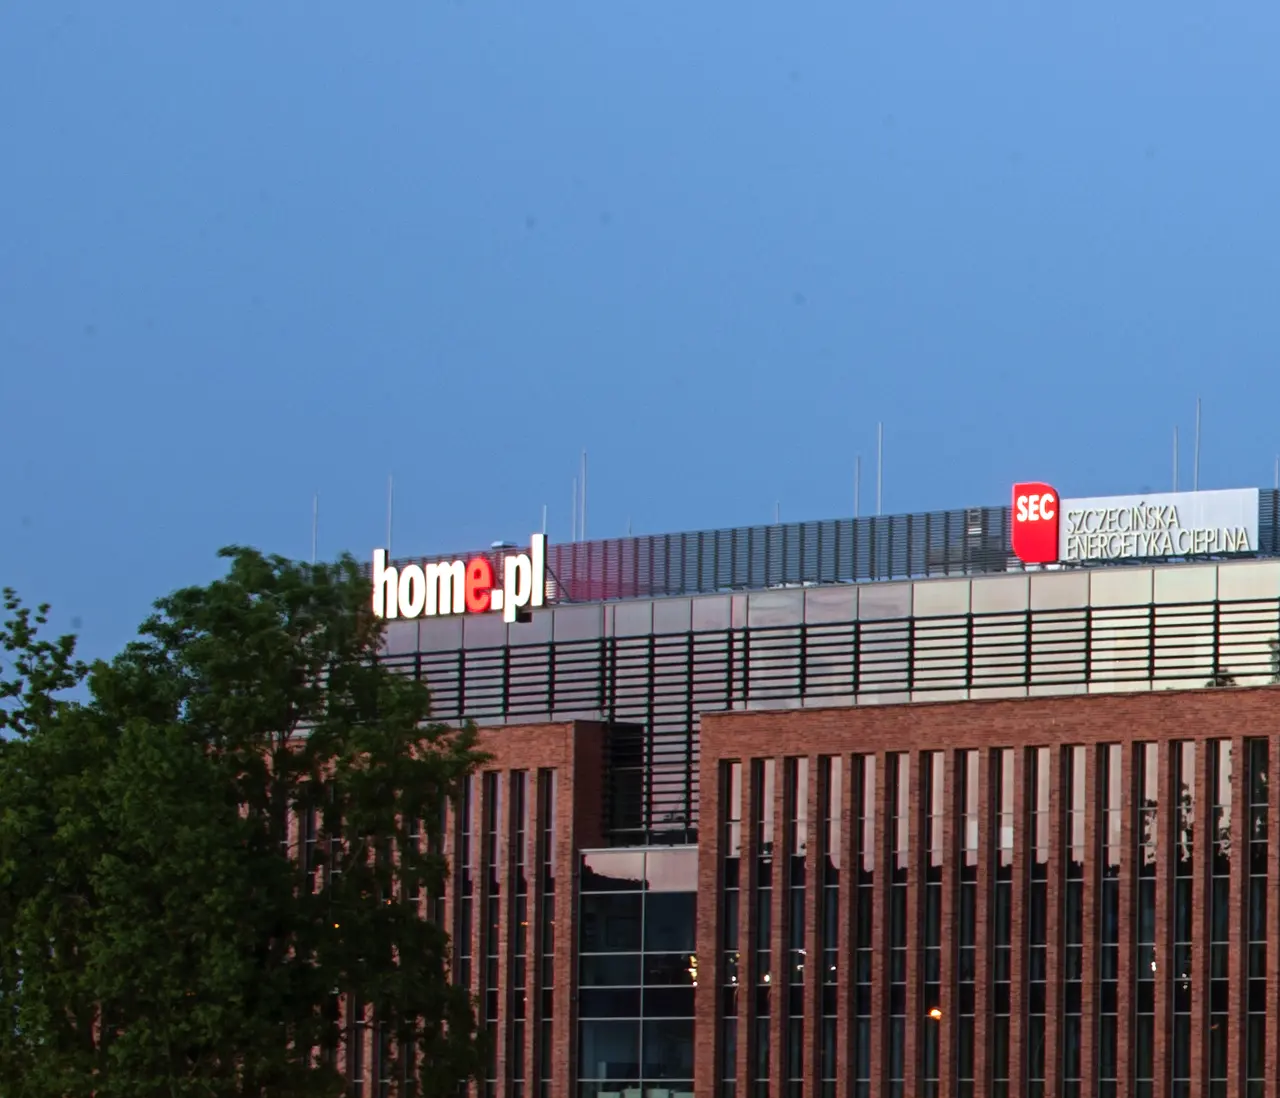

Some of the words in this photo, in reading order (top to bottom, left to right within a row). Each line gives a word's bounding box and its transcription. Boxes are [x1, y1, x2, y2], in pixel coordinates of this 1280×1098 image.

[1016, 493, 1055, 522] SEC
[1067, 502, 1180, 534] SZCZECIŃSKA
[1066, 530, 1176, 561] ENERGETYKA
[1178, 526, 1252, 555] CIEPLNA
[372, 533, 546, 624] home.pl
